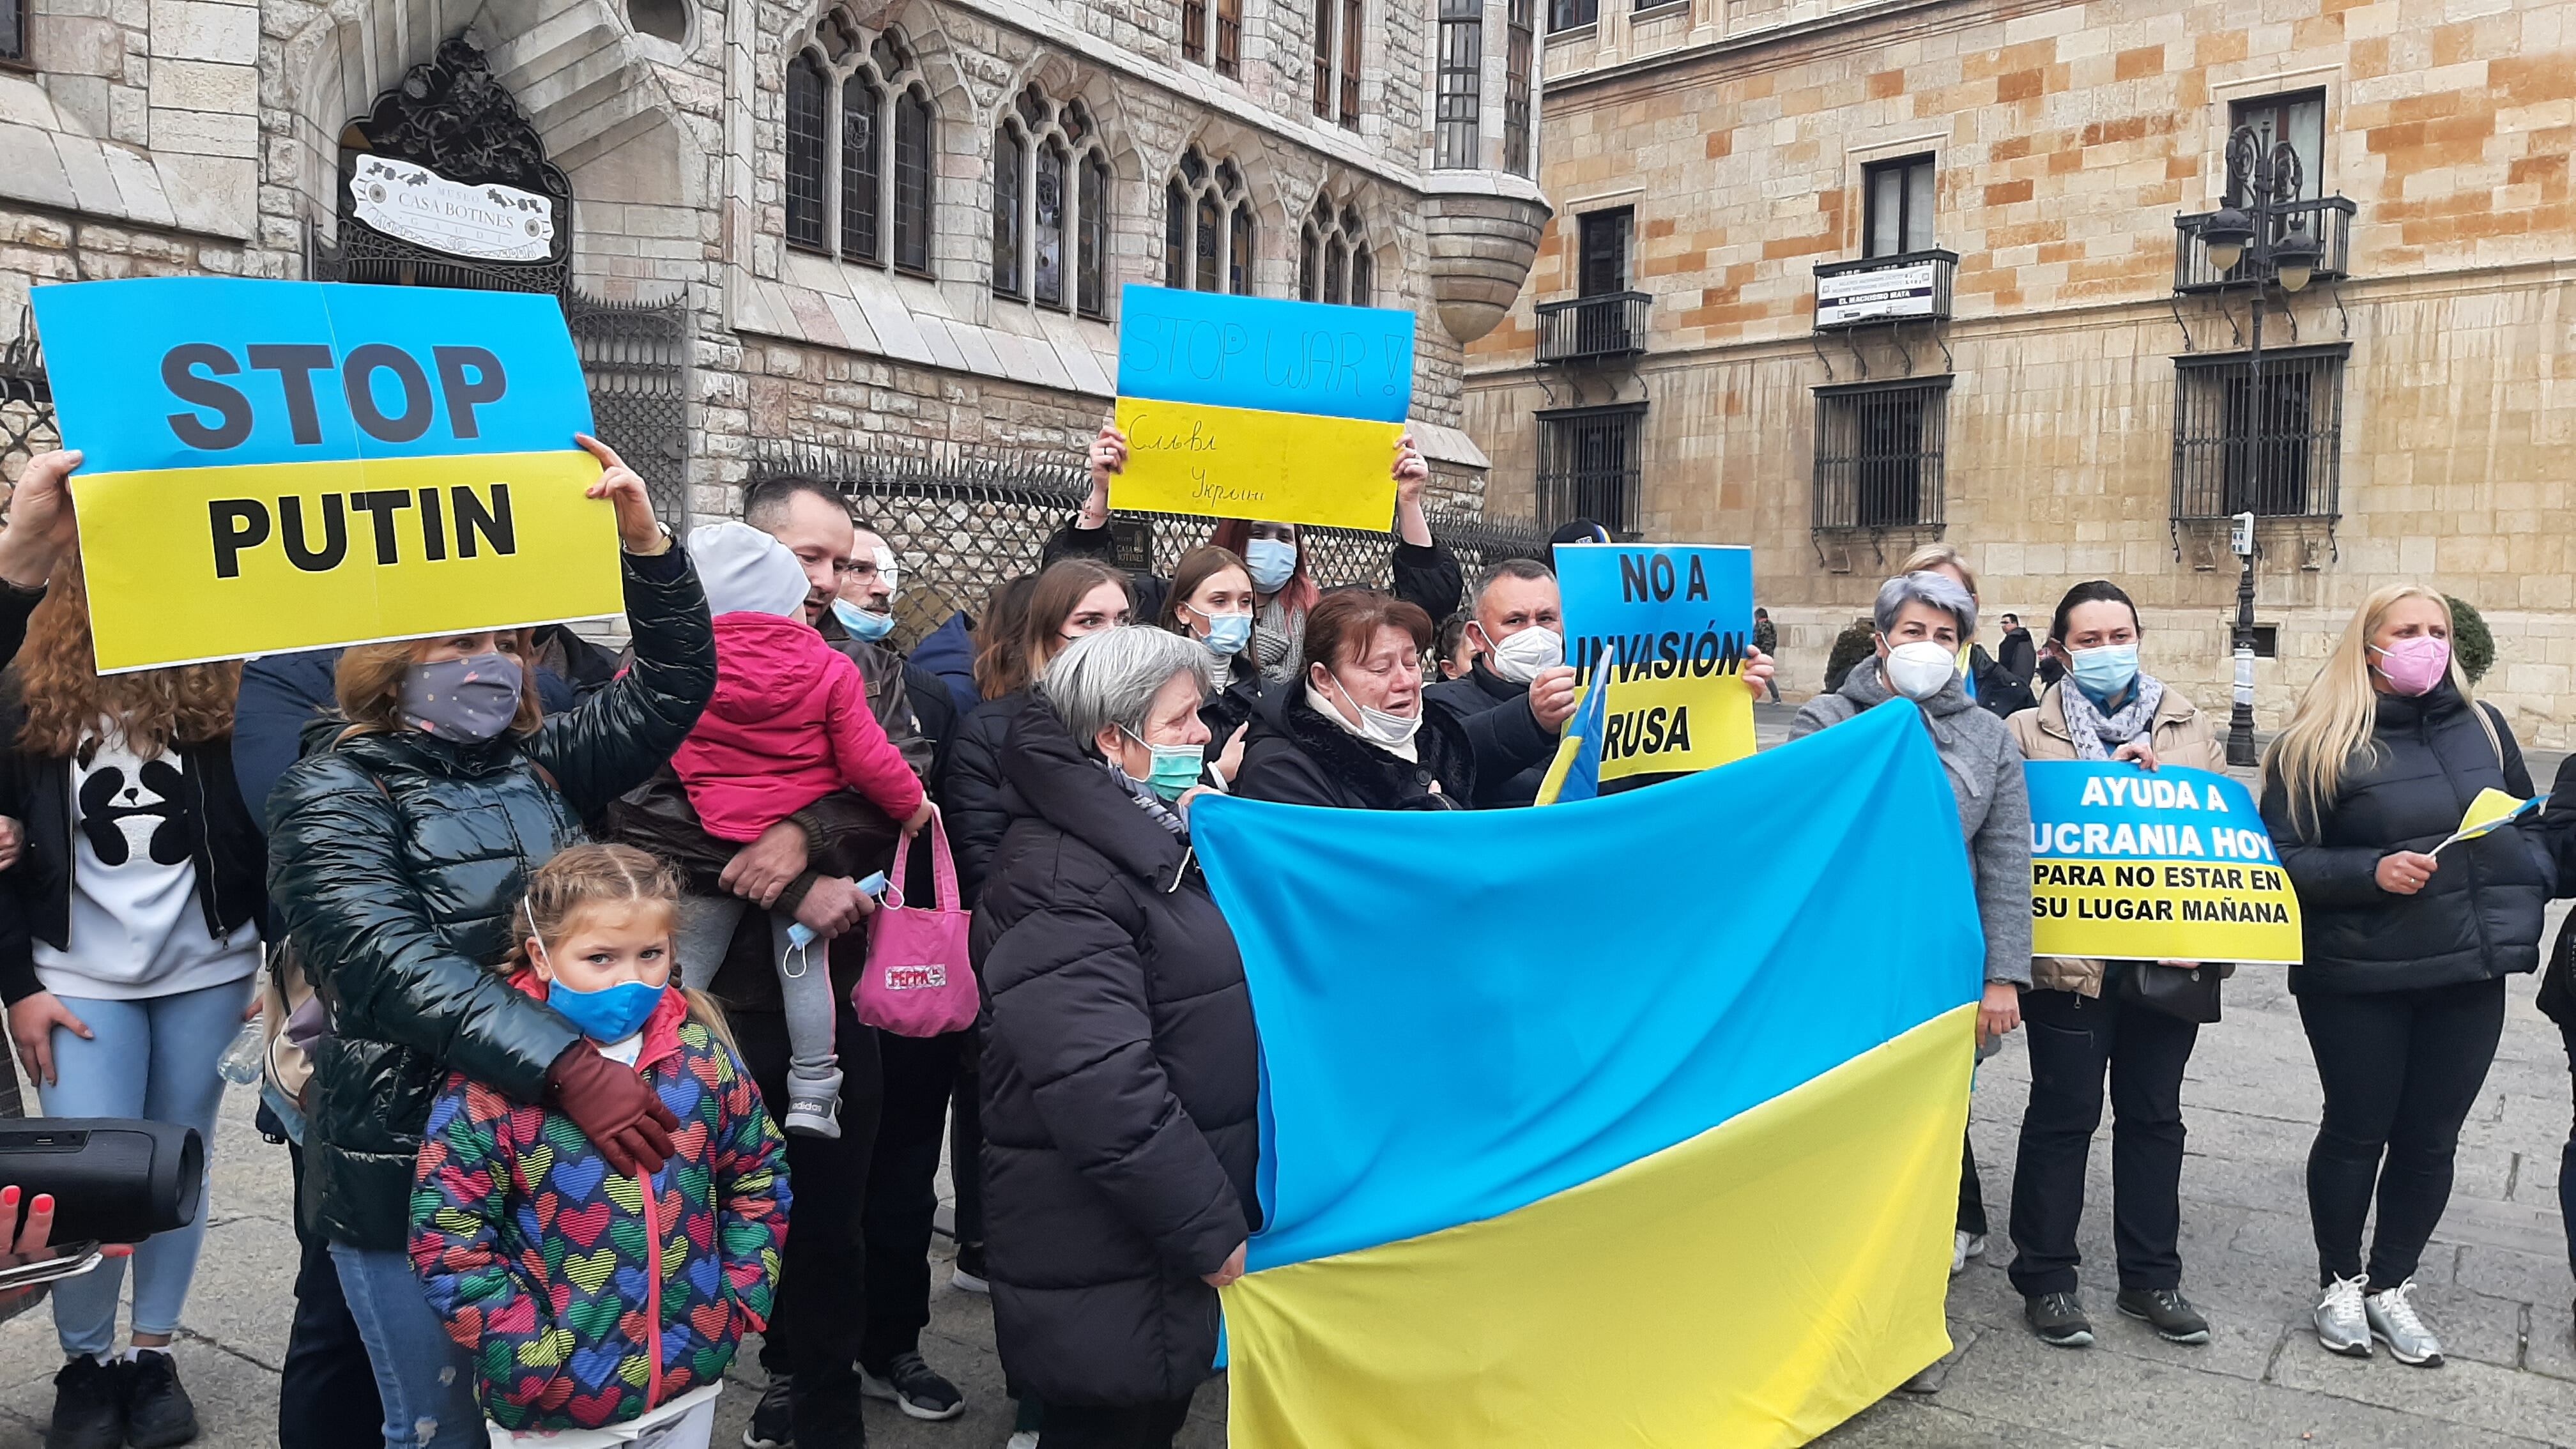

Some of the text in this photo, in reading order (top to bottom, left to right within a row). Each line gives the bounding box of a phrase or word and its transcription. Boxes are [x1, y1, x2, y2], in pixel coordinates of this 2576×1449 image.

[399, 192, 514, 229] CASA BOTINES
[438, 187, 479, 203] MUSEO
[1124, 313, 1248, 381] STOP
[1264, 330, 1367, 397] WAR
[160, 342, 507, 450] STOP
[208, 484, 516, 579] PUTIN
[1618, 553, 1710, 603] NO A
[1574, 619, 1744, 687] INVASIÓN
[1600, 705, 1691, 762] RUSA
[2080, 776, 2229, 813] AYUDA A
[2030, 822, 2274, 861] UCRANIA HOY
[2034, 864, 2282, 891] PARA NO ESTAR EN
[2032, 896, 2289, 924] SU LUGAR MAÑANA
